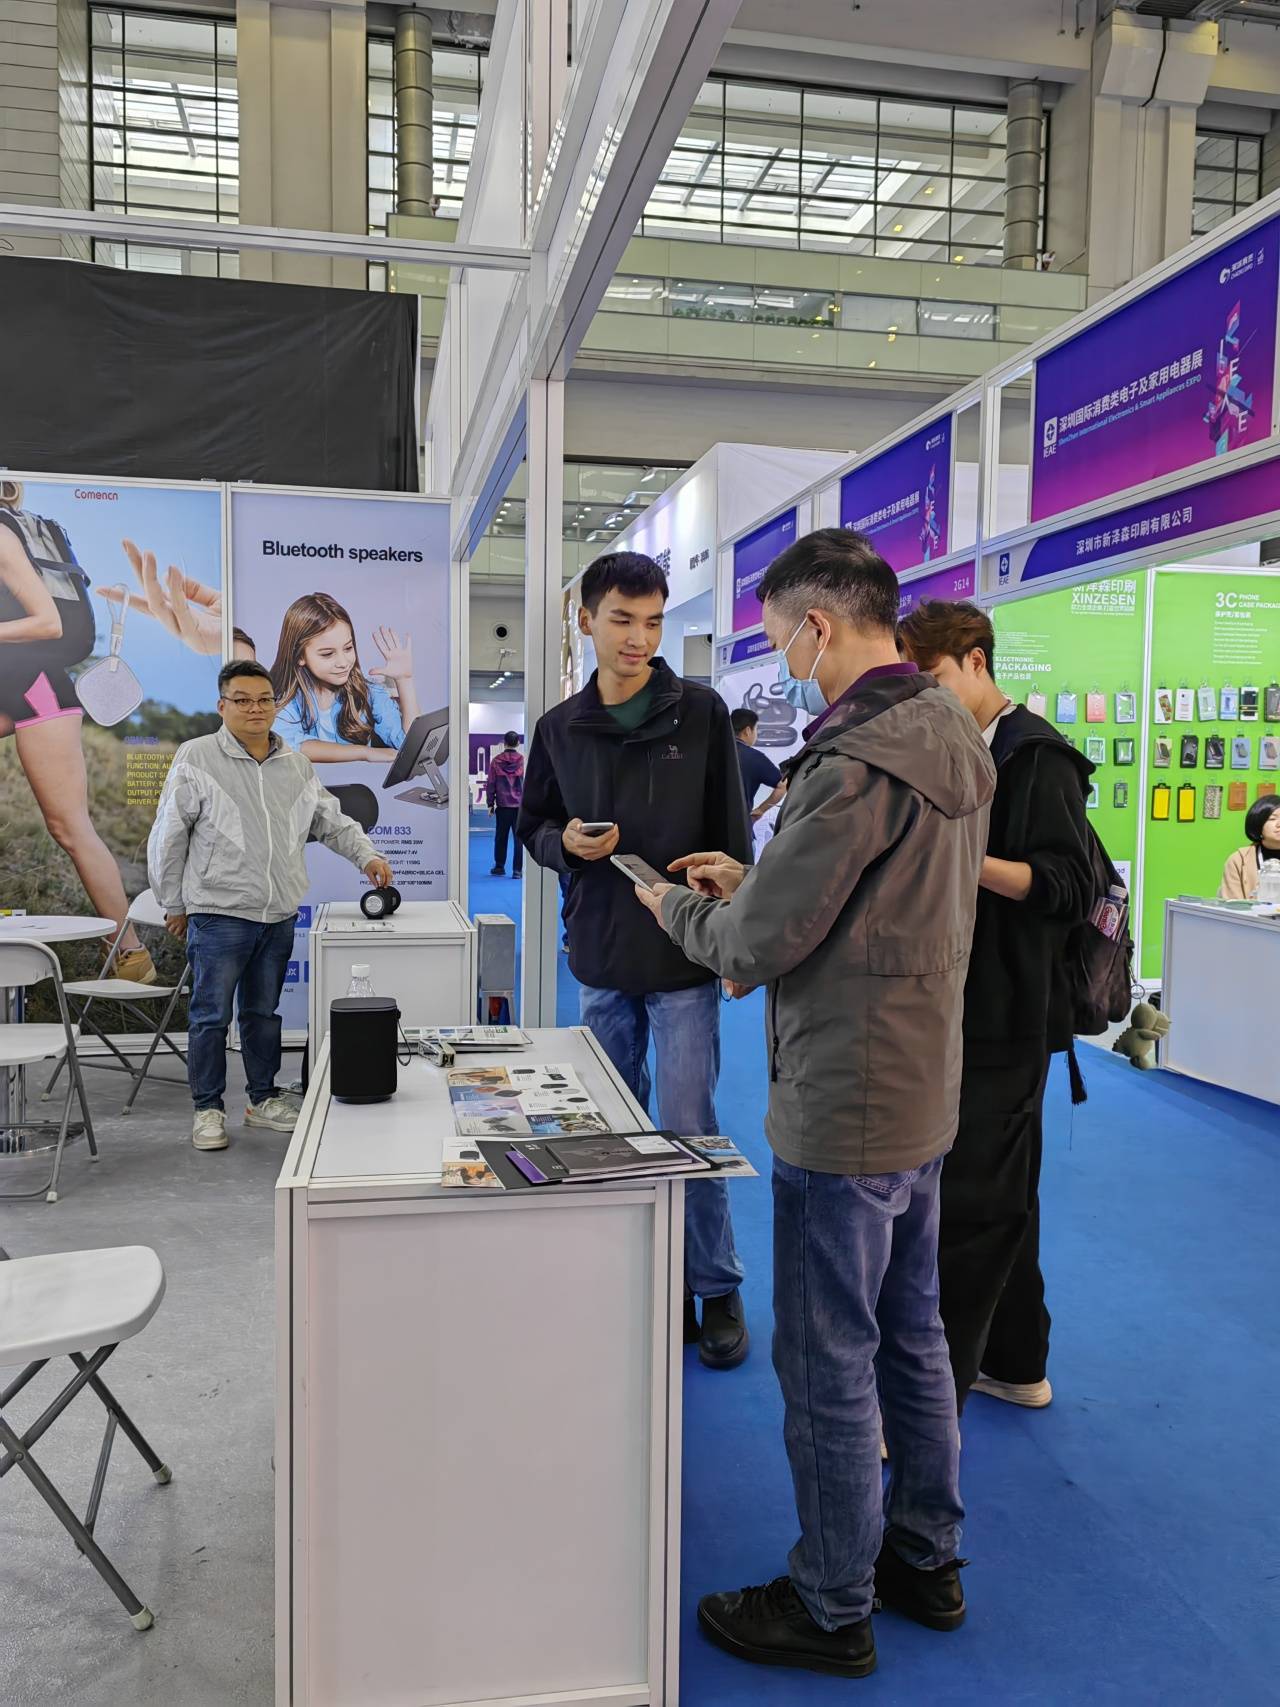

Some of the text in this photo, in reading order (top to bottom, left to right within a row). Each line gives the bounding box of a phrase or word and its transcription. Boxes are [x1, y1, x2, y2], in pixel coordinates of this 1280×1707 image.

[1059, 349, 1203, 433] 深圳国际消费类电子及家用电器展
[1043, 444, 1057, 458] IEAE
[1076, 506, 1193, 556] 深圳市新泽森印刷有限公司
[262, 540, 423, 563] Bluetooth speakers
[953, 577, 970, 591] 2G14
[1072, 592, 1136, 606] XINZESEN
[1215, 591, 1238, 608] 3C
[994, 663, 1052, 672] PACKAGING
[126, 753, 165, 761] BLUETOOTH
[368, 825, 412, 836] COM 833
